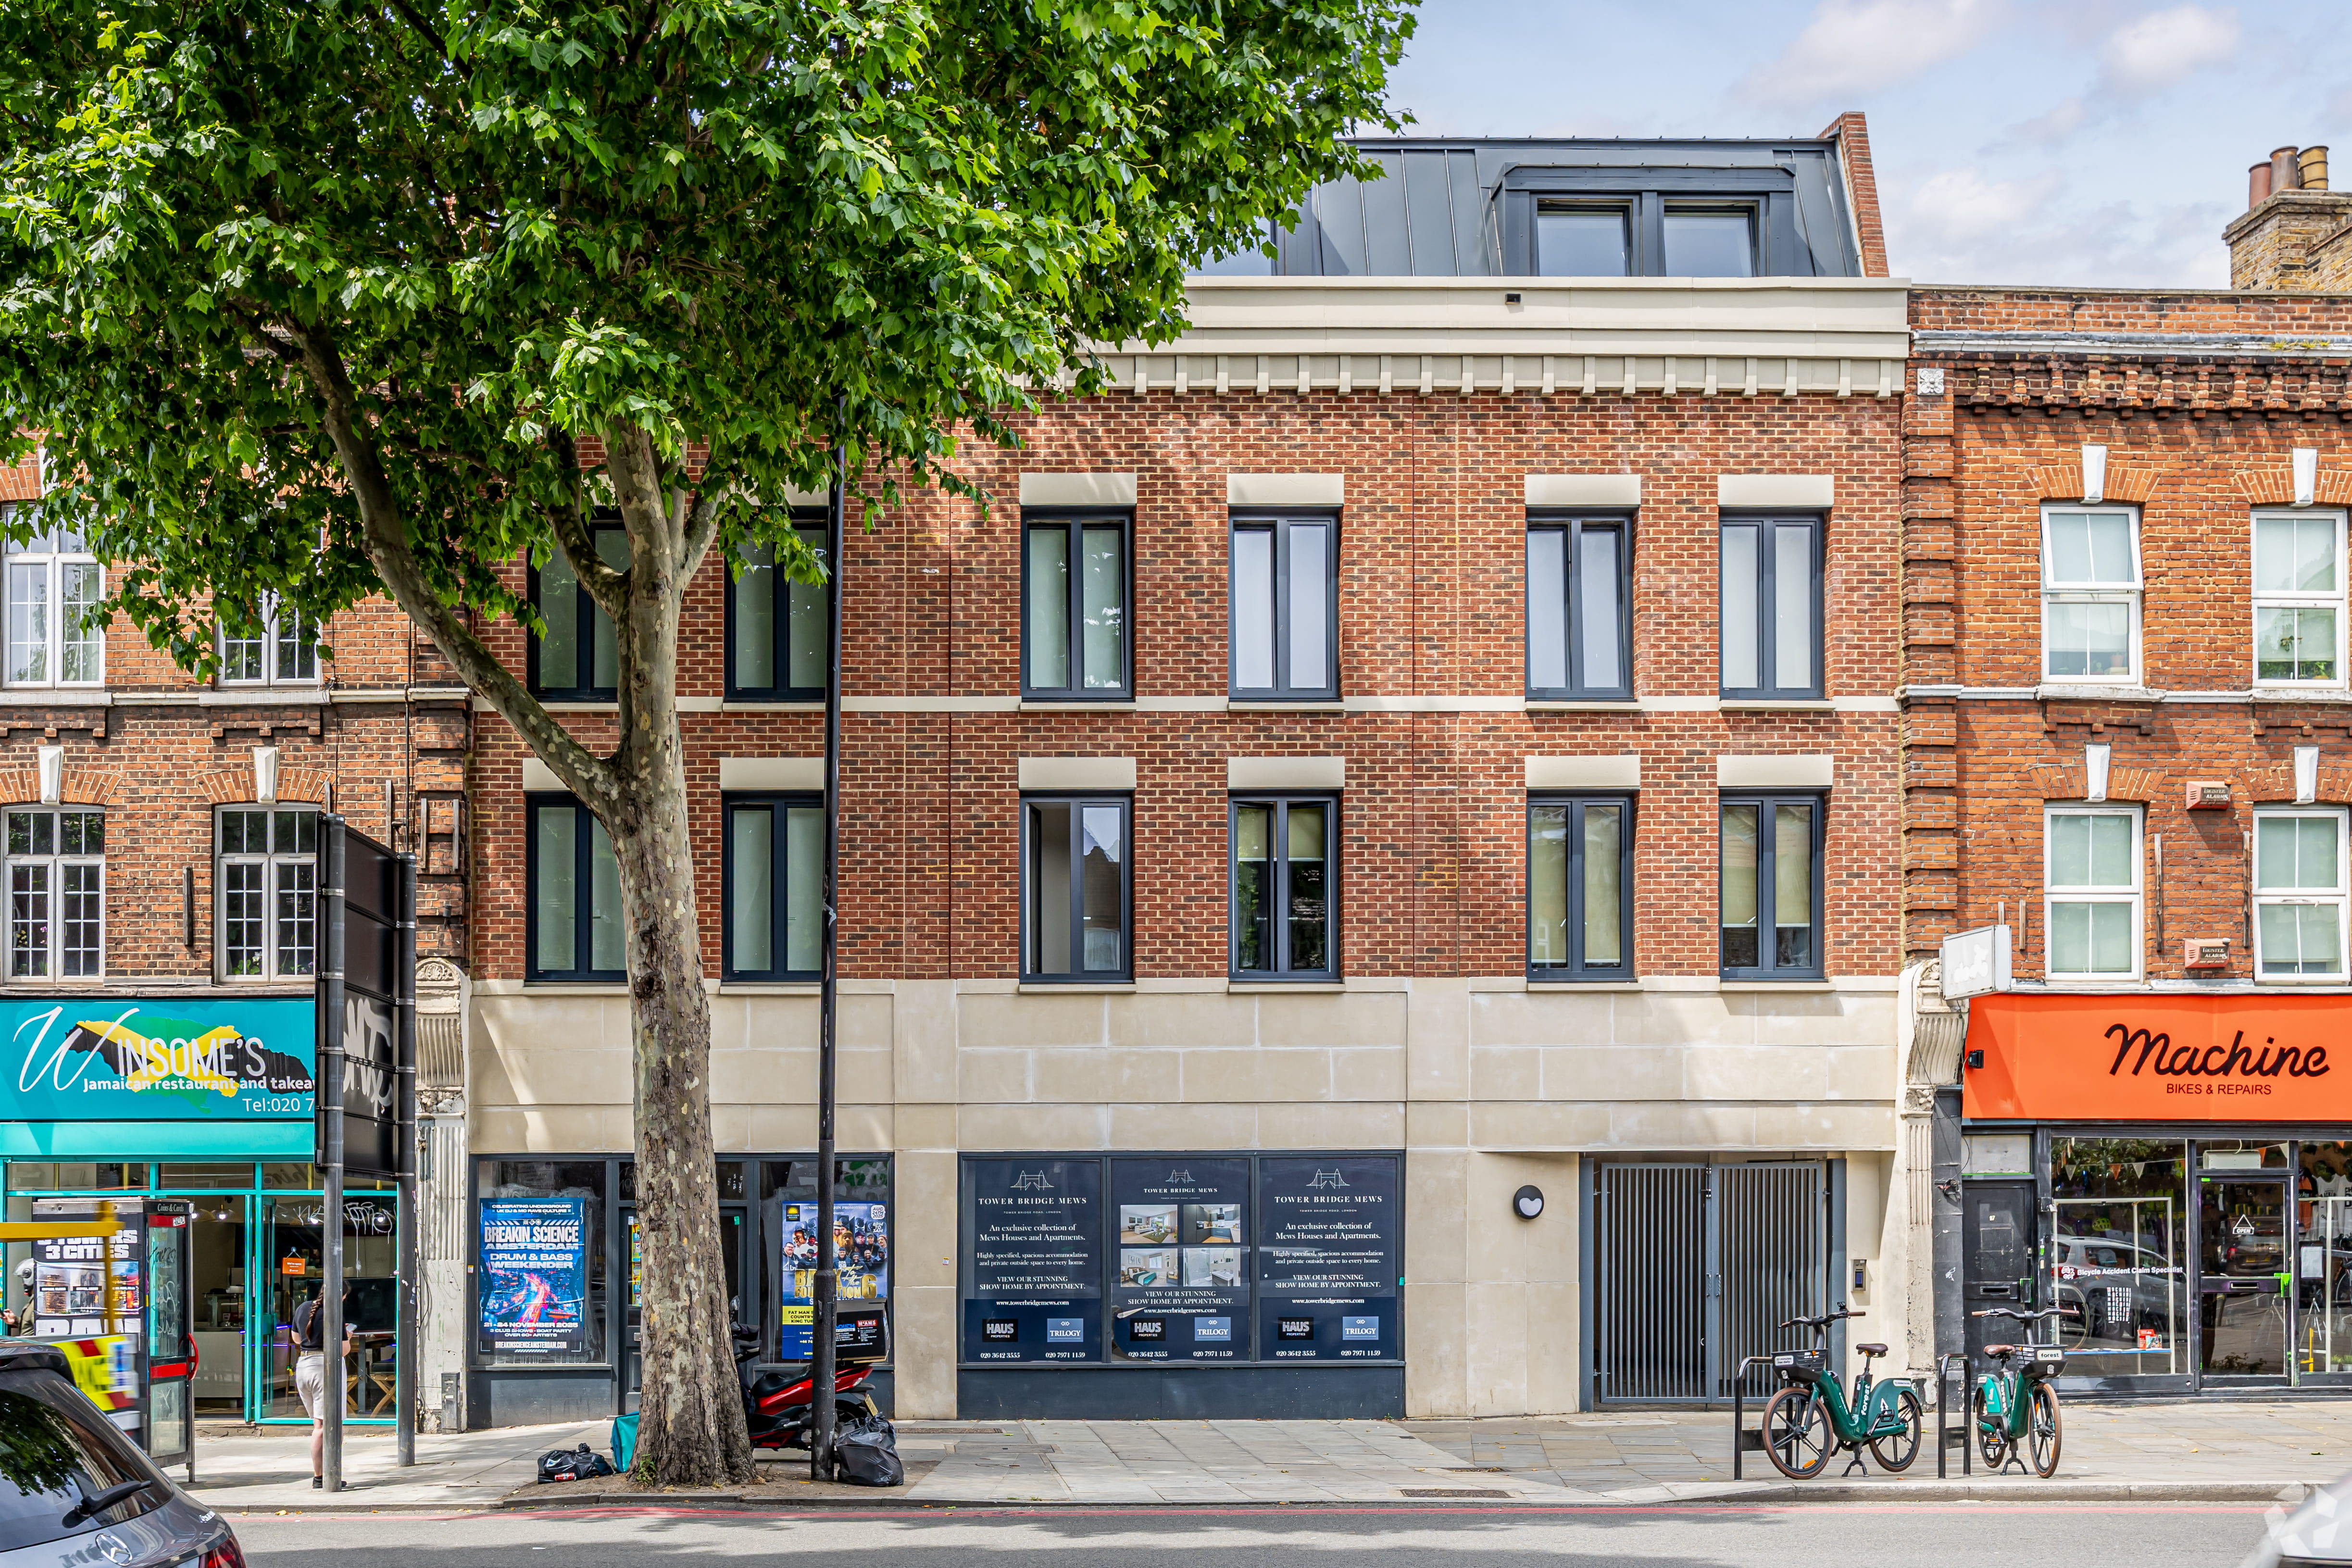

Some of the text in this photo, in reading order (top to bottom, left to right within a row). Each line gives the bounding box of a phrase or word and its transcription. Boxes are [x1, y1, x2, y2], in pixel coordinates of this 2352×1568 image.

[2104, 1023, 2330, 1077] Machine
[83, 1076, 315, 1093] Jamaican restaurant and takea
[2166, 1084, 2272, 1095] BIKES & REPAIRS
[242, 1098, 300, 1112] Tel:020
[485, 1226, 579, 1242] BREAKIN SCIENCE
[1044, 1234, 1086, 1242] Apartments.
[1339, 1232, 1381, 1241] Apartments.
[45, 1245, 61, 1259] 3
[795, 1268, 842, 1287] BAK
[794, 1286, 861, 1298] FOUTION
[861, 1274, 877, 1299] 6
[987, 1323, 1014, 1334] HAUS
[1134, 1322, 1162, 1333] HAUS
[1282, 1321, 1310, 1332] HAUS
[1861, 1384, 1871, 1416] forest
